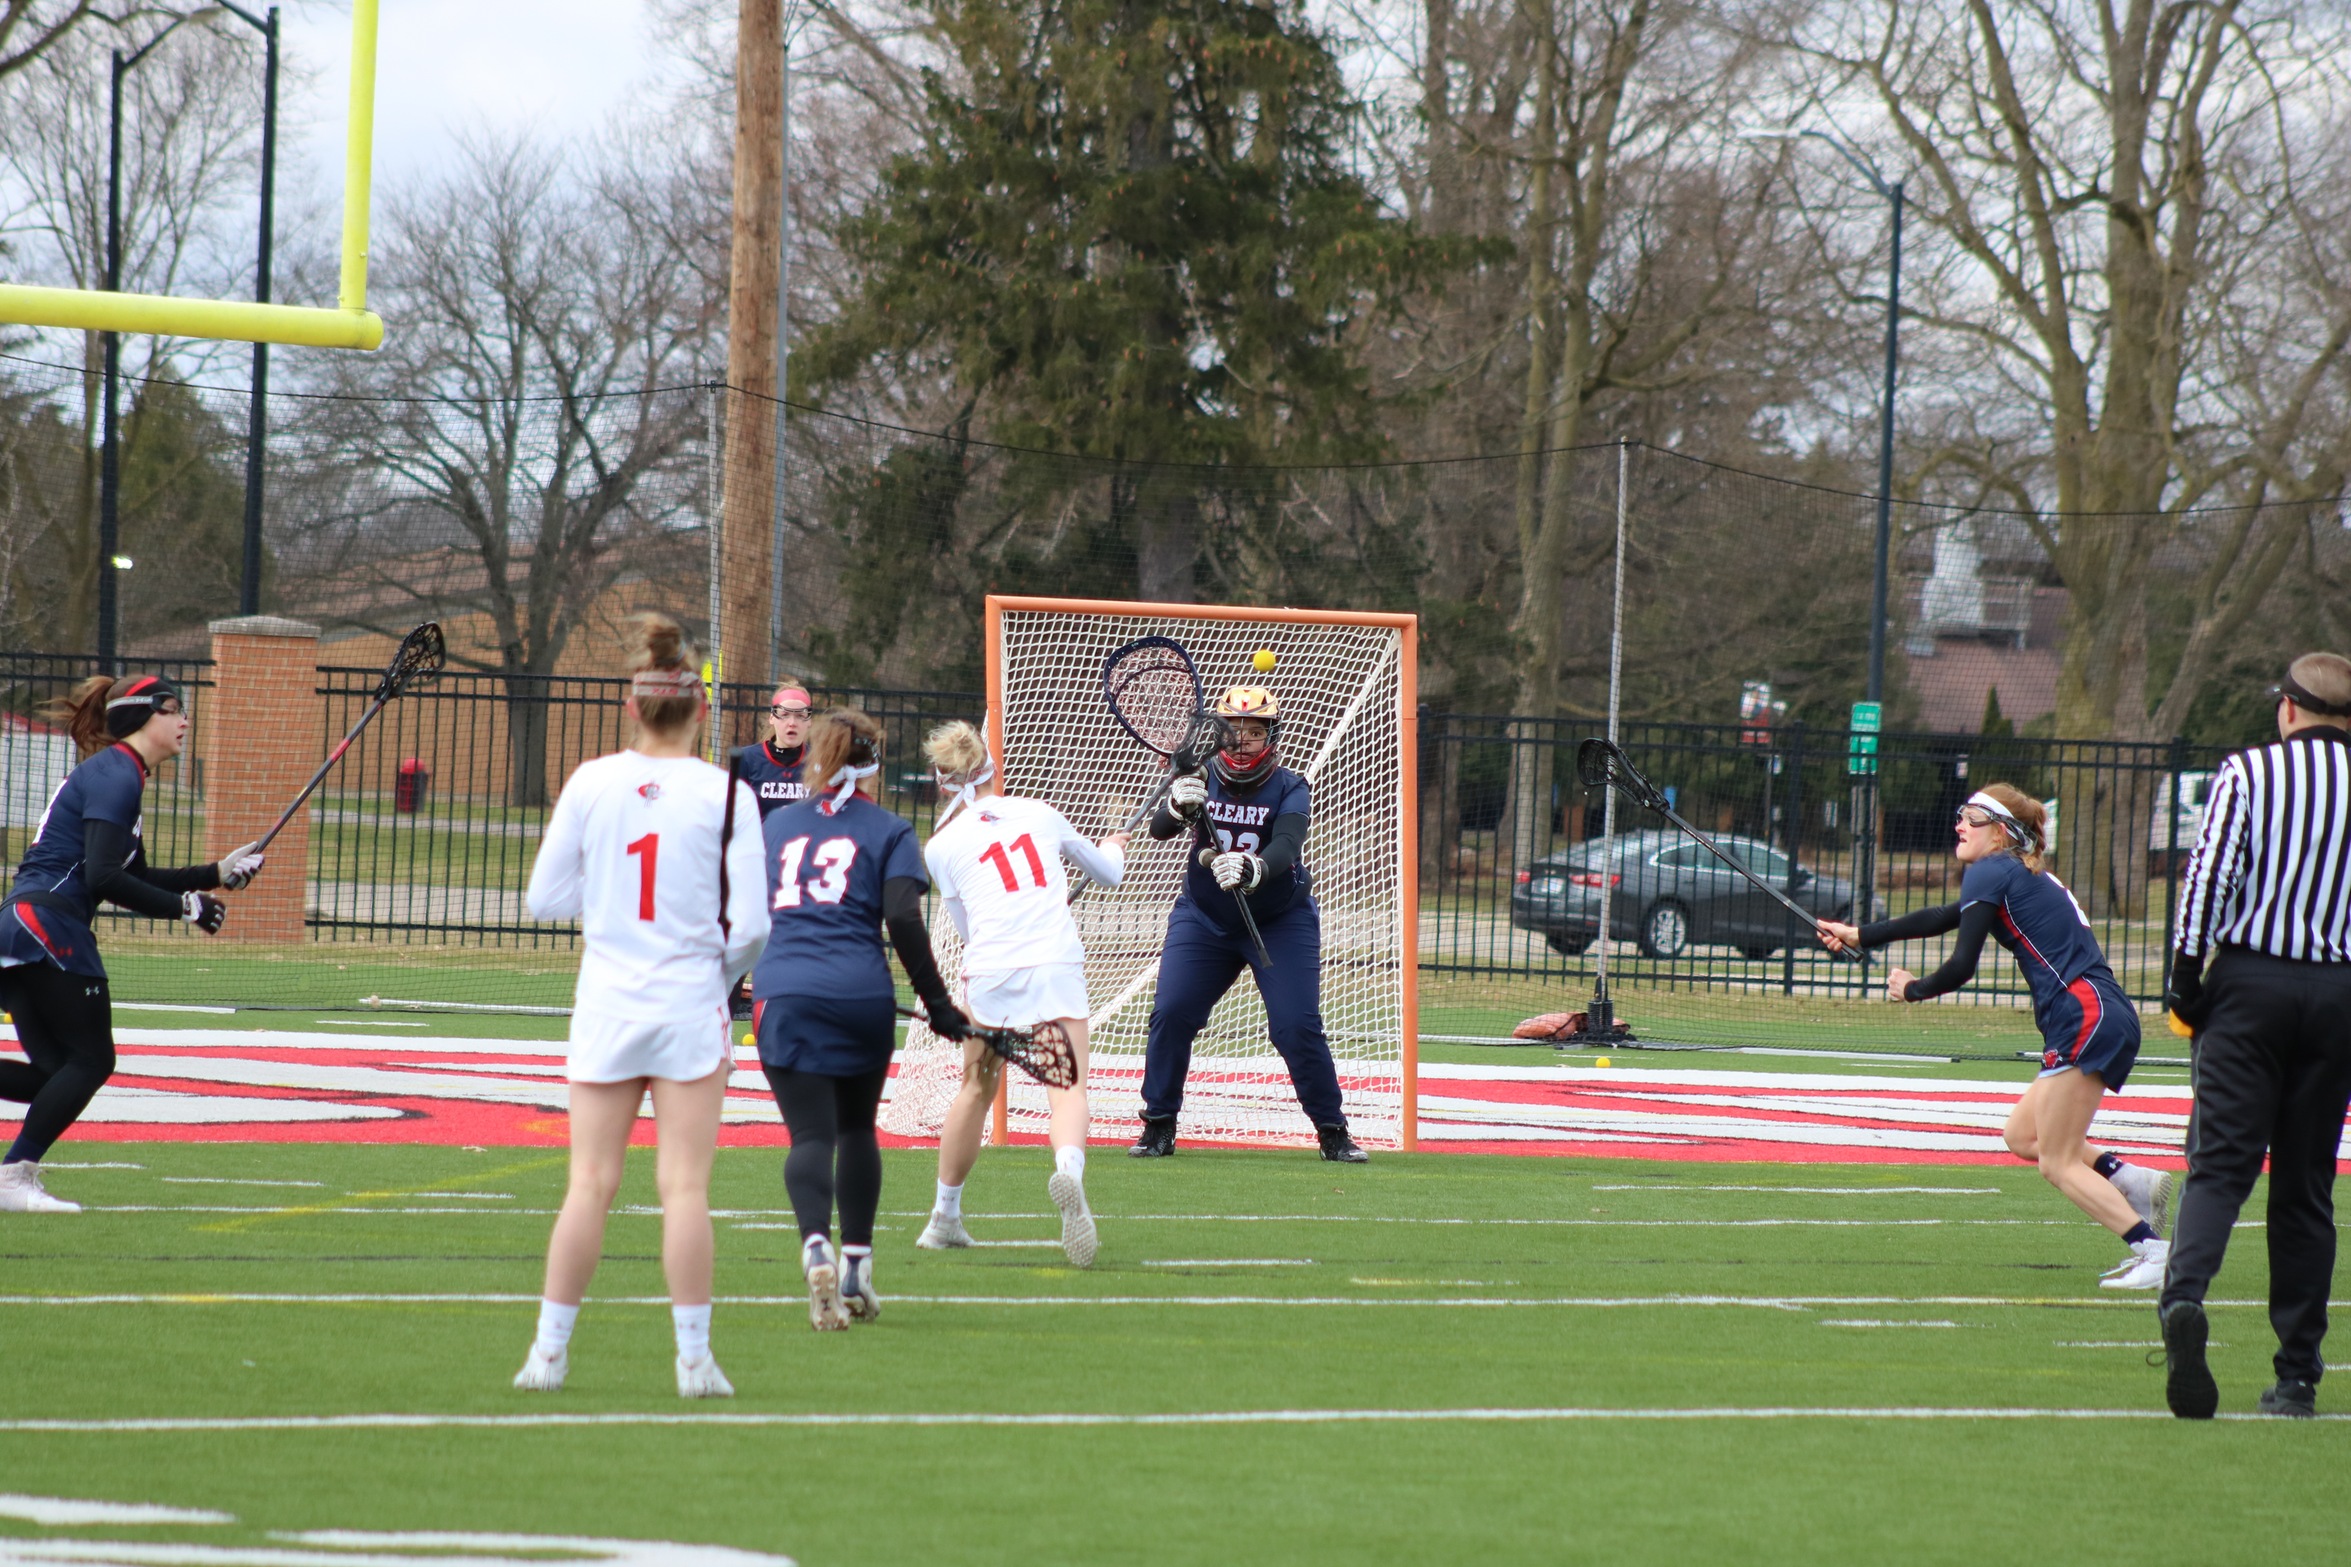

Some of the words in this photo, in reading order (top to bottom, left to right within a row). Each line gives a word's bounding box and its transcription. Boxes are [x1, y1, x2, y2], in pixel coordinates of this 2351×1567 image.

[1206, 800, 1269, 826] CLEARY
[627, 832, 659, 922] 1
[774, 836, 857, 909] 13
[979, 833, 1047, 893] 11
